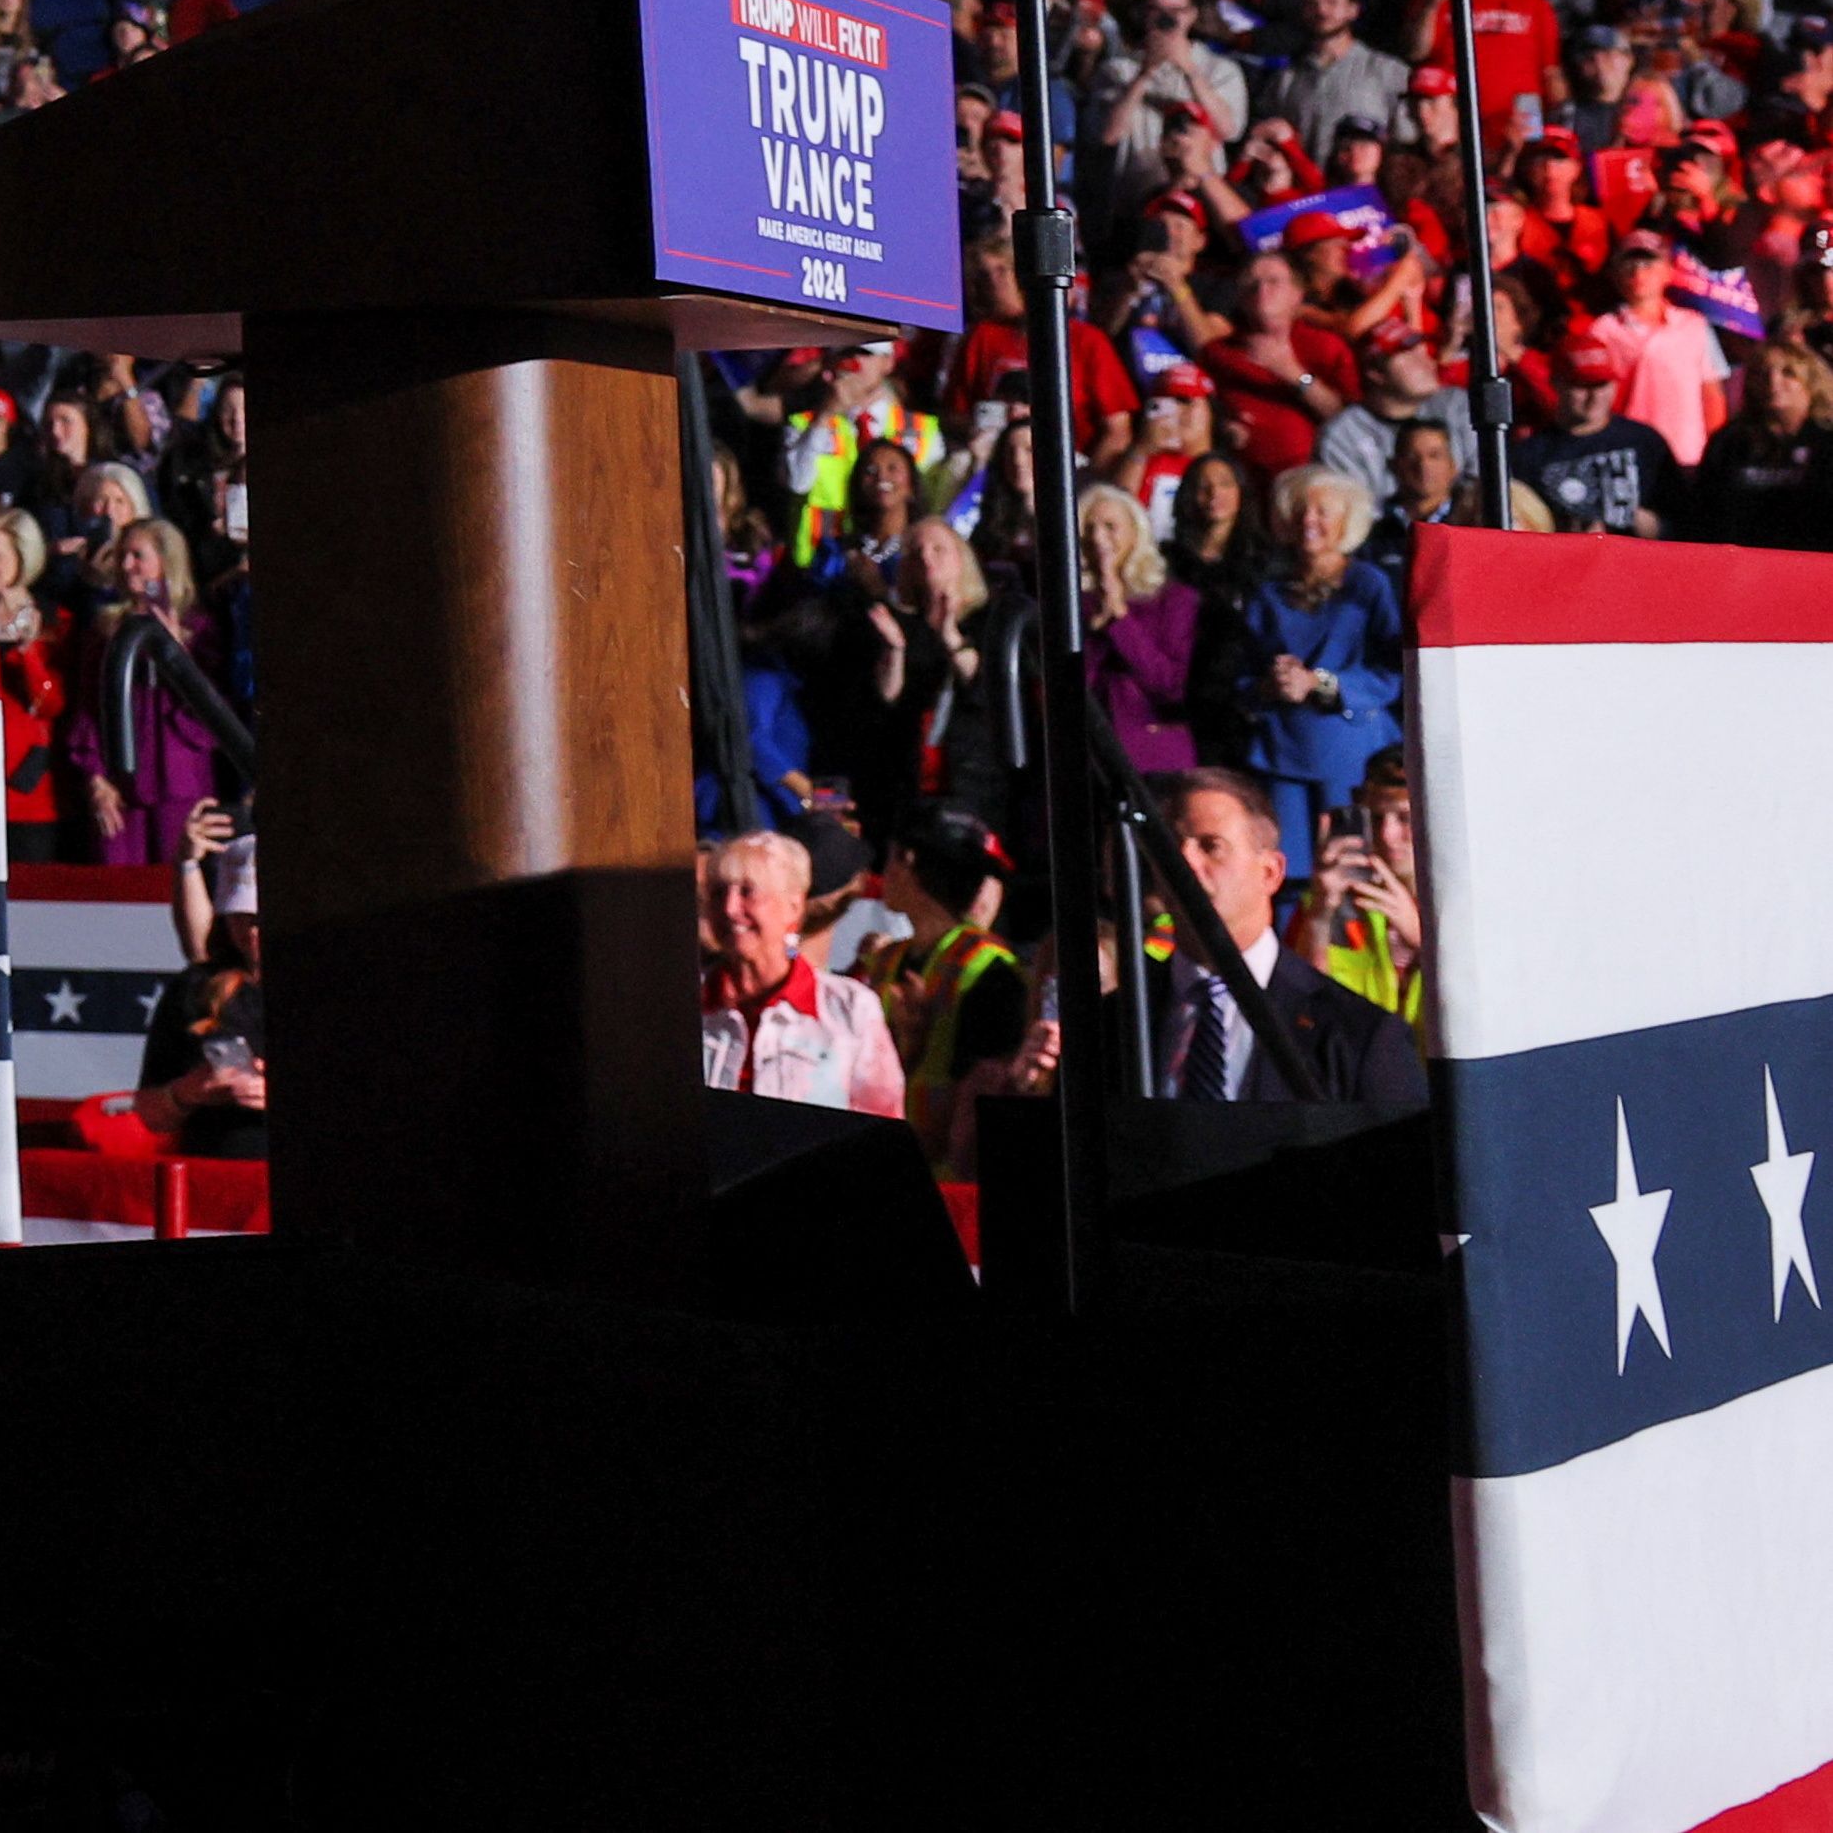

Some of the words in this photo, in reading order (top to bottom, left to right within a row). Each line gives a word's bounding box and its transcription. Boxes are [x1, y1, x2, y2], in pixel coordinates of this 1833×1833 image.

[795, 3, 837, 52] WILL
[837, 16, 865, 61] FIX
[864, 25, 881, 65] IT
[739, 36, 885, 158] TRUMP
[760, 136, 875, 231] VANCE
[758, 216, 785, 241] MAKE
[785, 222, 825, 250] AMERICA
[825, 231, 852, 255] GREAT
[854, 237, 883, 263] AGAIN!
[801, 256, 847, 303] 2024
